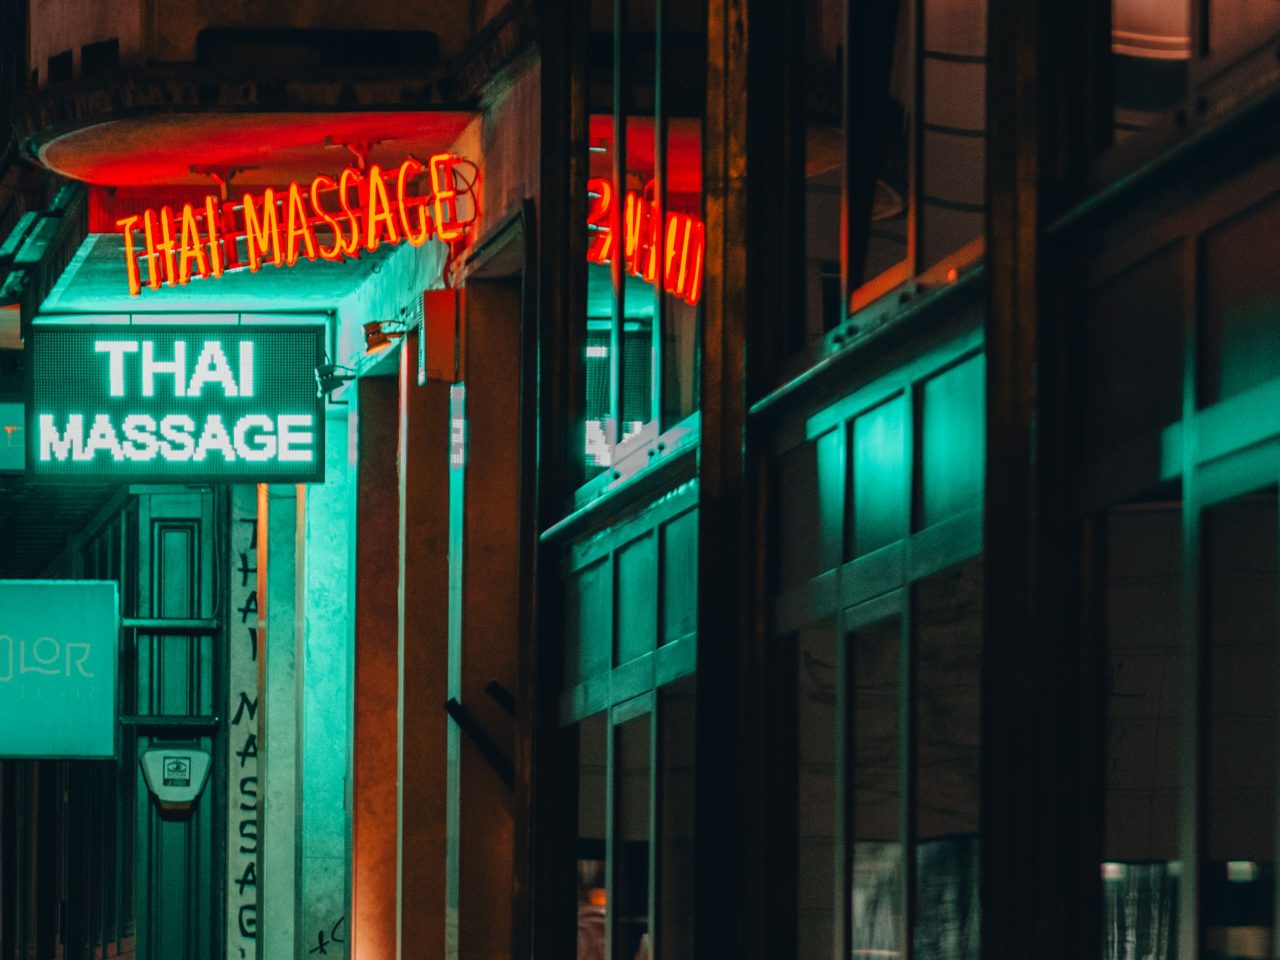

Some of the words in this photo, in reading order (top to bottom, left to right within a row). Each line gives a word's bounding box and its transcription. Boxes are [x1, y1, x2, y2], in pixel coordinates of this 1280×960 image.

[116, 194, 223, 296] THAI
[242, 152, 461, 273] MASSAGE
[94, 340, 254, 397] THAI
[38, 413, 313, 462] MASSAGE
